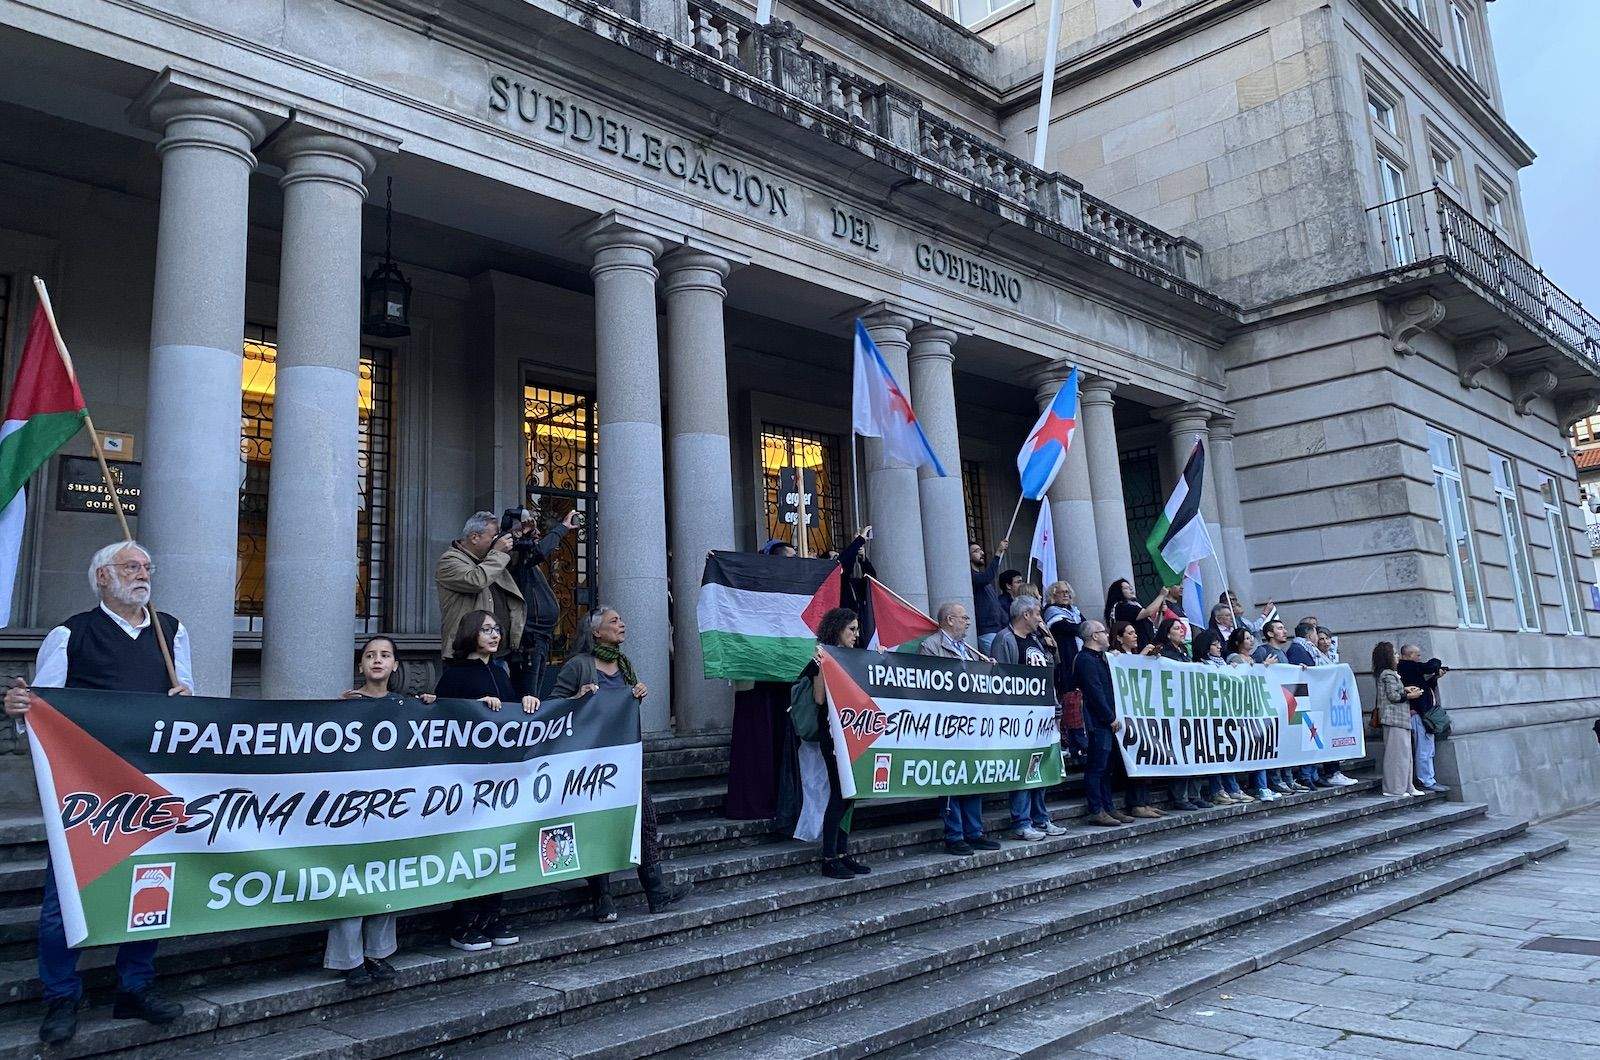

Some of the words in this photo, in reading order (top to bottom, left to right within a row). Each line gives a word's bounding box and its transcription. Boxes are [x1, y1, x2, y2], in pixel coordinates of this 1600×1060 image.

[489, 75, 790, 217] SUBDELEGACION
[830, 206, 879, 252] DEL
[916, 242, 1022, 304] GOBIERNO
[786, 493, 812, 507] erger
[958, 672, 970, 692] O
[972, 673, 1047, 696] XENOCIDIO!
[1114, 666, 1156, 717] PAZ
[1160, 670, 1175, 717] E
[1180, 671, 1279, 718] LIBERDADE
[150, 719, 361, 755] ¡PAREMOS
[372, 720, 398, 749] O
[408, 710, 574, 750] XENOCIDIO!
[840, 708, 929, 742] PALESTINA
[934, 713, 977, 741] LIBRE
[980, 717, 994, 738] DO
[999, 716, 1020, 739] RIO
[1330, 697, 1353, 733] bng
[1123, 716, 1178, 765] PARA
[1180, 717, 1279, 764] PALESTINA!
[902, 759, 969, 786] FOLGA
[972, 759, 1021, 784] XERAL
[59, 786, 295, 845] PALESTINA
[303, 786, 416, 836] LIBRE
[421, 785, 462, 818] DO
[473, 779, 518, 816] RIO
[533, 762, 552, 804] Ó
[562, 763, 618, 804] MAR
[207, 843, 517, 909] SOLIDARIEDADE
[133, 910, 166, 926] CGT
